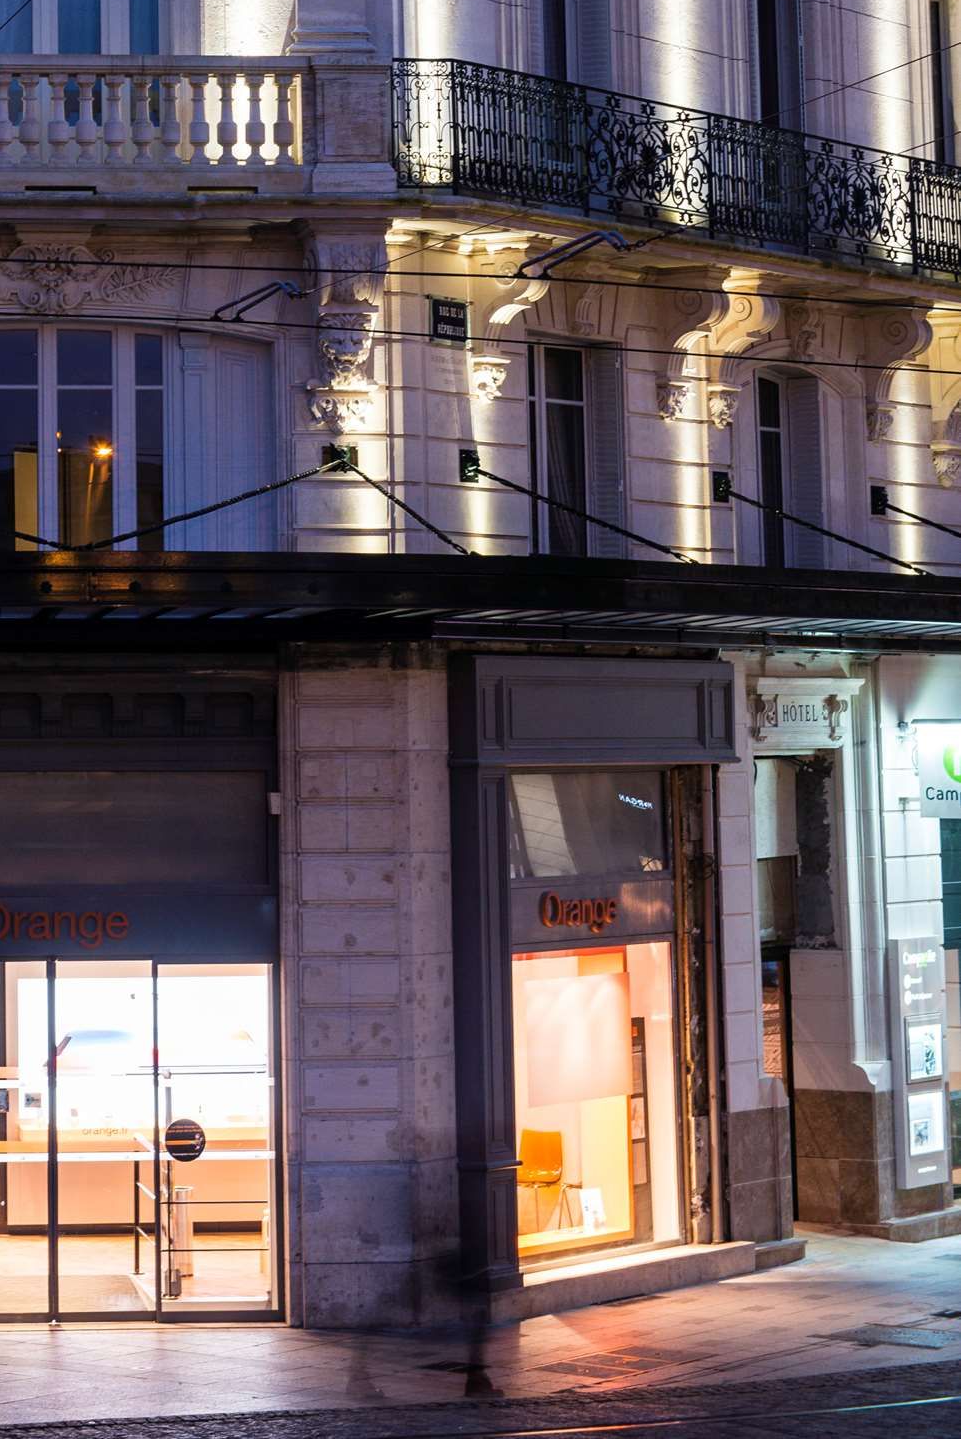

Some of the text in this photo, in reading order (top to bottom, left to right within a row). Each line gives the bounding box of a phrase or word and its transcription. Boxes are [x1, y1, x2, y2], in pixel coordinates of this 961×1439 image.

[782, 701, 818, 722] HÔTEL
[925, 786, 961, 806] Cam
[539, 890, 617, 933] Orange
